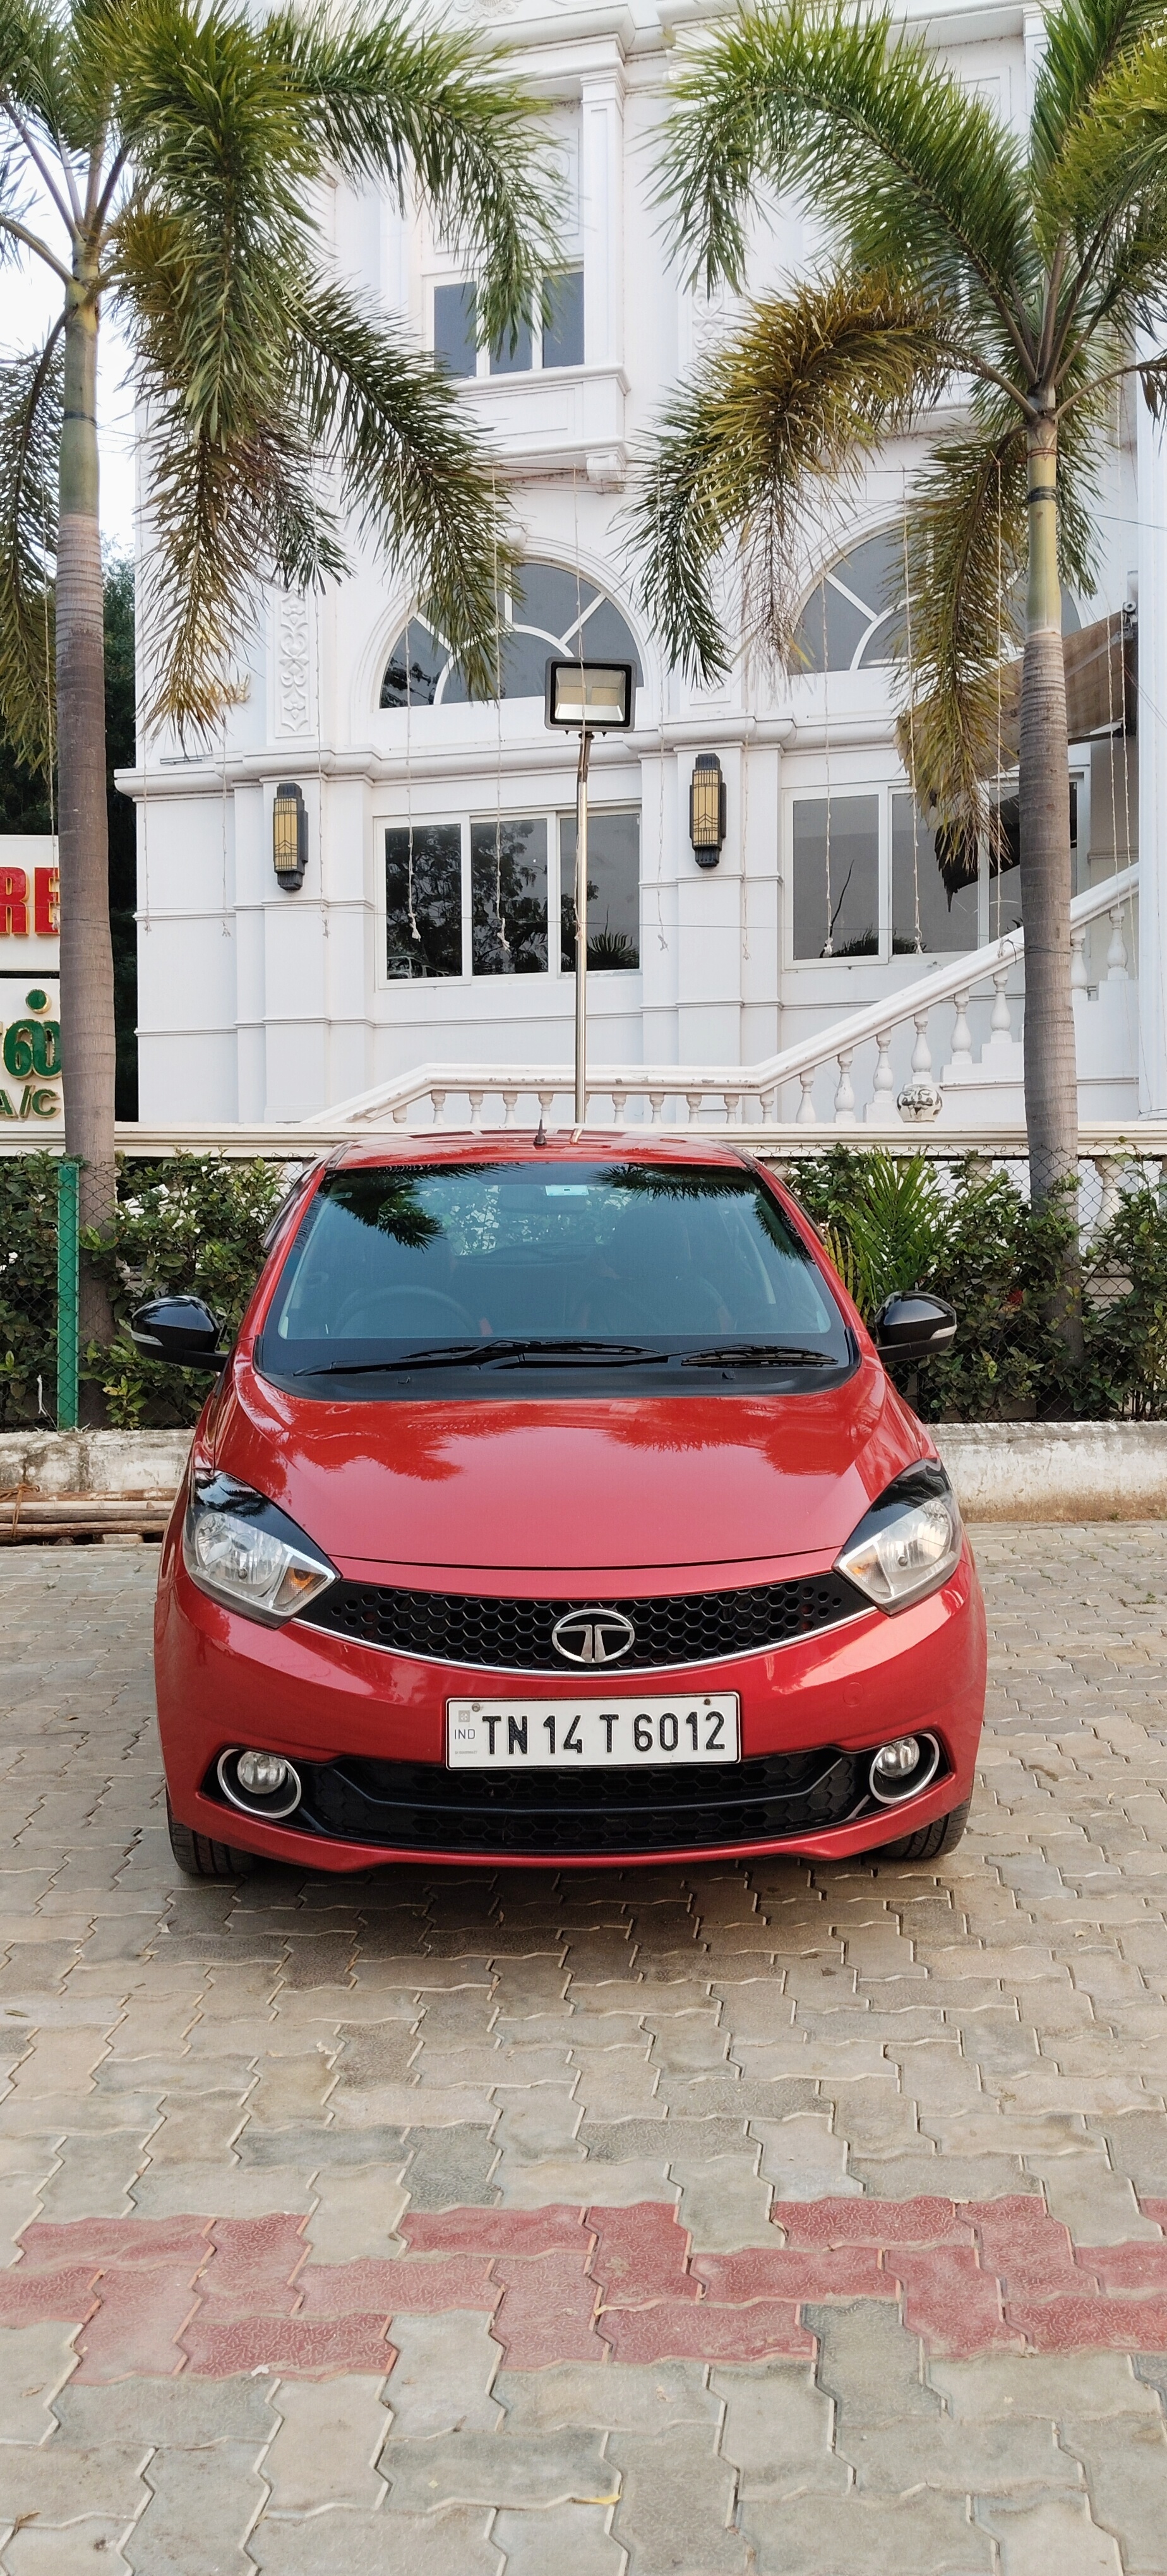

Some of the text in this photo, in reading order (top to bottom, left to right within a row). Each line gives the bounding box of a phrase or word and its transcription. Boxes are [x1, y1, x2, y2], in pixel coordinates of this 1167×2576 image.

[0, 866, 60, 935] RE
[454, 1729, 476, 1739] IND
[482, 1711, 726, 1755] TN 14 T 6012
